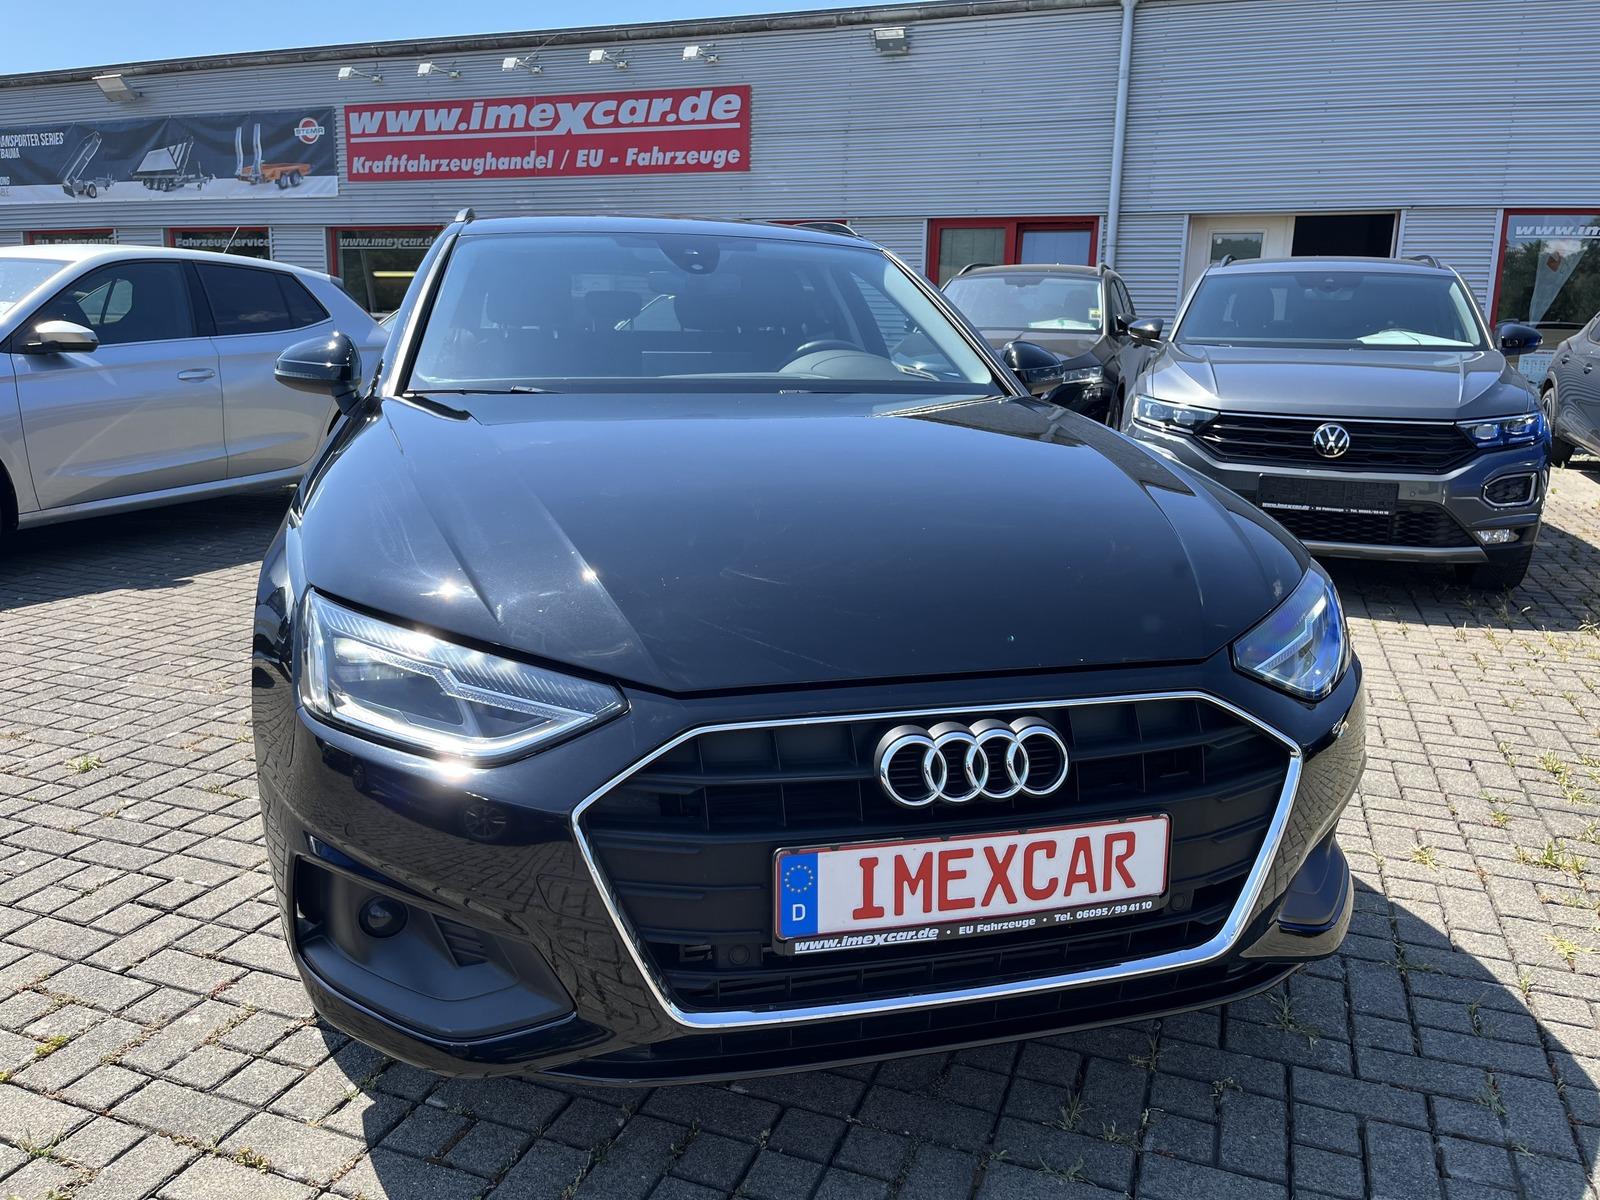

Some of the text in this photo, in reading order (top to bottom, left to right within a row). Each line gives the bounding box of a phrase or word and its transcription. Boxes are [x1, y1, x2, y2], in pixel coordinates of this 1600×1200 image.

[349, 90, 742, 135] www.imexcar.de
[40, 132, 64, 146] SERIES
[352, 150, 555, 175] Kraftfahrzeughandel
[575, 149, 604, 168] EU
[625, 146, 741, 169] Fahrzeuge
[852, 831, 1136, 921] IMEXCAR
[792, 903, 806, 921] D
[794, 927, 939, 952] www.imexcar.de
[958, 925, 974, 935] EU
[976, 917, 1036, 933] Fahrzeuge
[1054, 912, 1074, 922] Tel.
